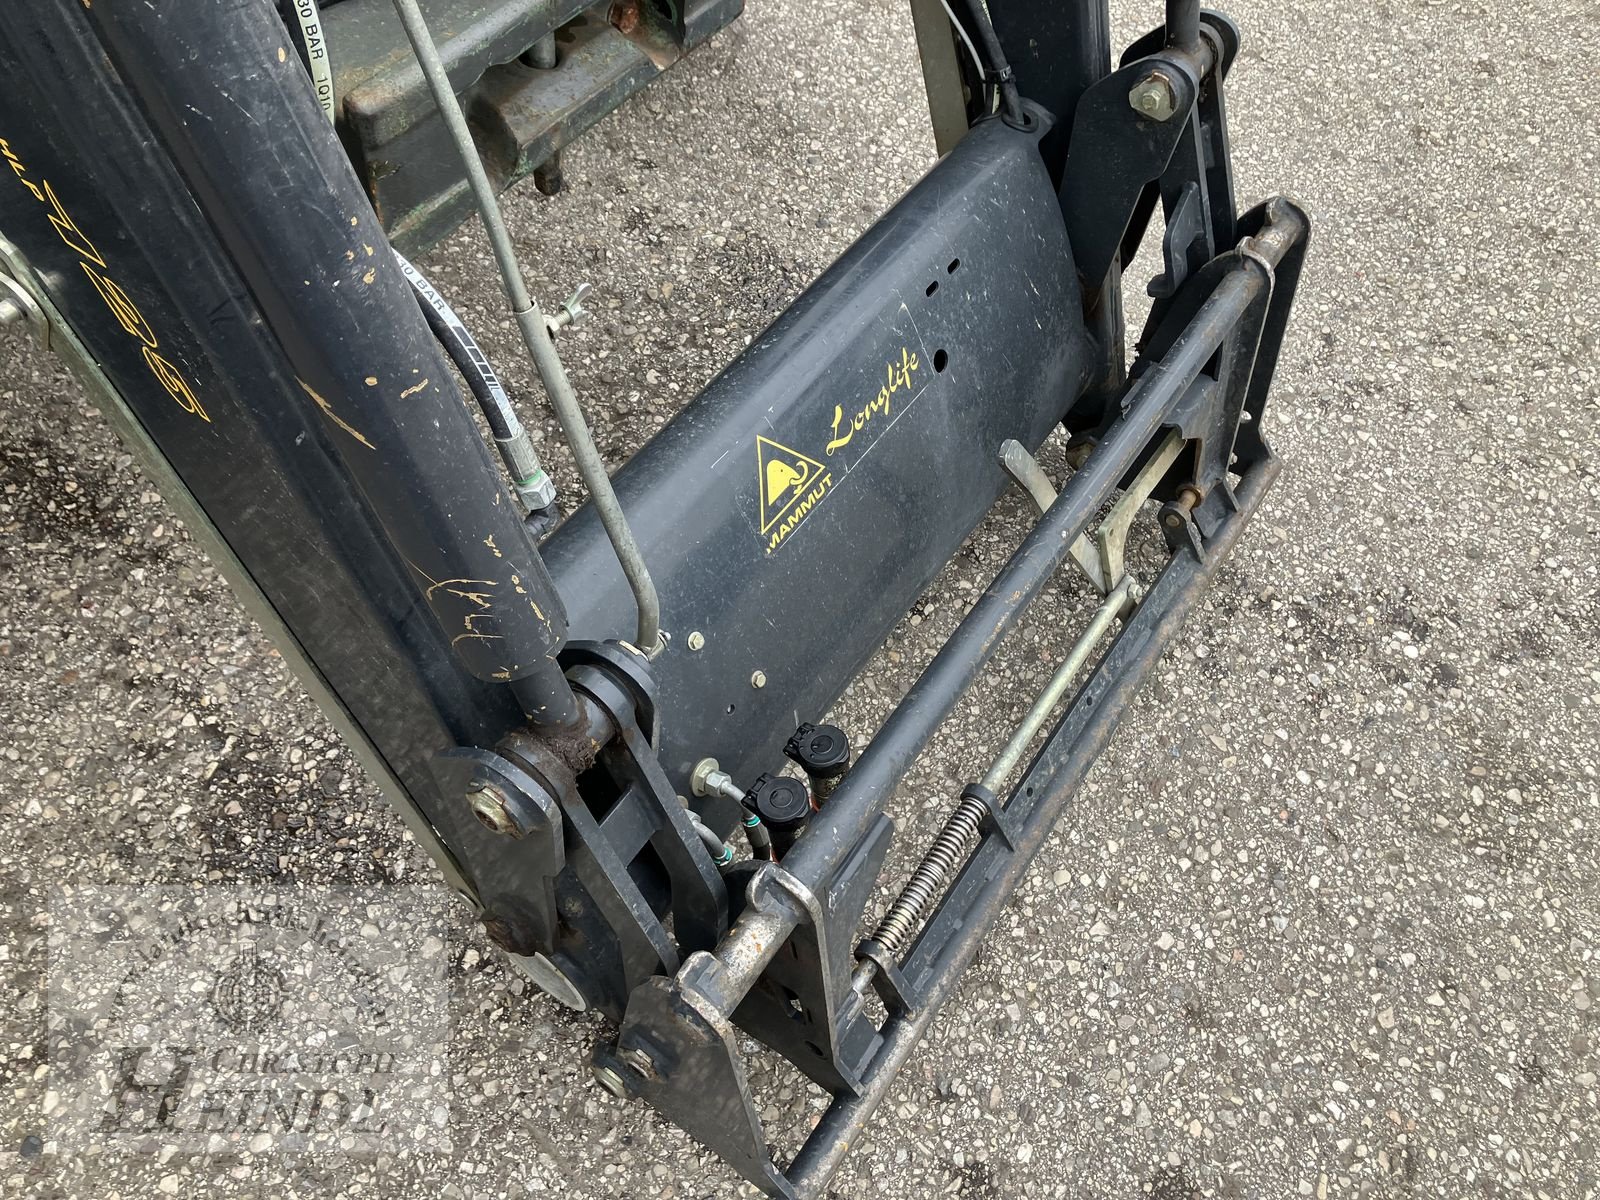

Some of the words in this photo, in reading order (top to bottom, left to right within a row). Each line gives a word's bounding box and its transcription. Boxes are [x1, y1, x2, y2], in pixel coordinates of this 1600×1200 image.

[305, 24, 324, 59] BAR
[0, 138, 45, 202] HLP
[44, 179, 211, 422] 125
[416, 280, 445, 310] BAR
[826, 347, 919, 456] Longlife
[766, 473, 833, 554] MAMMUT
